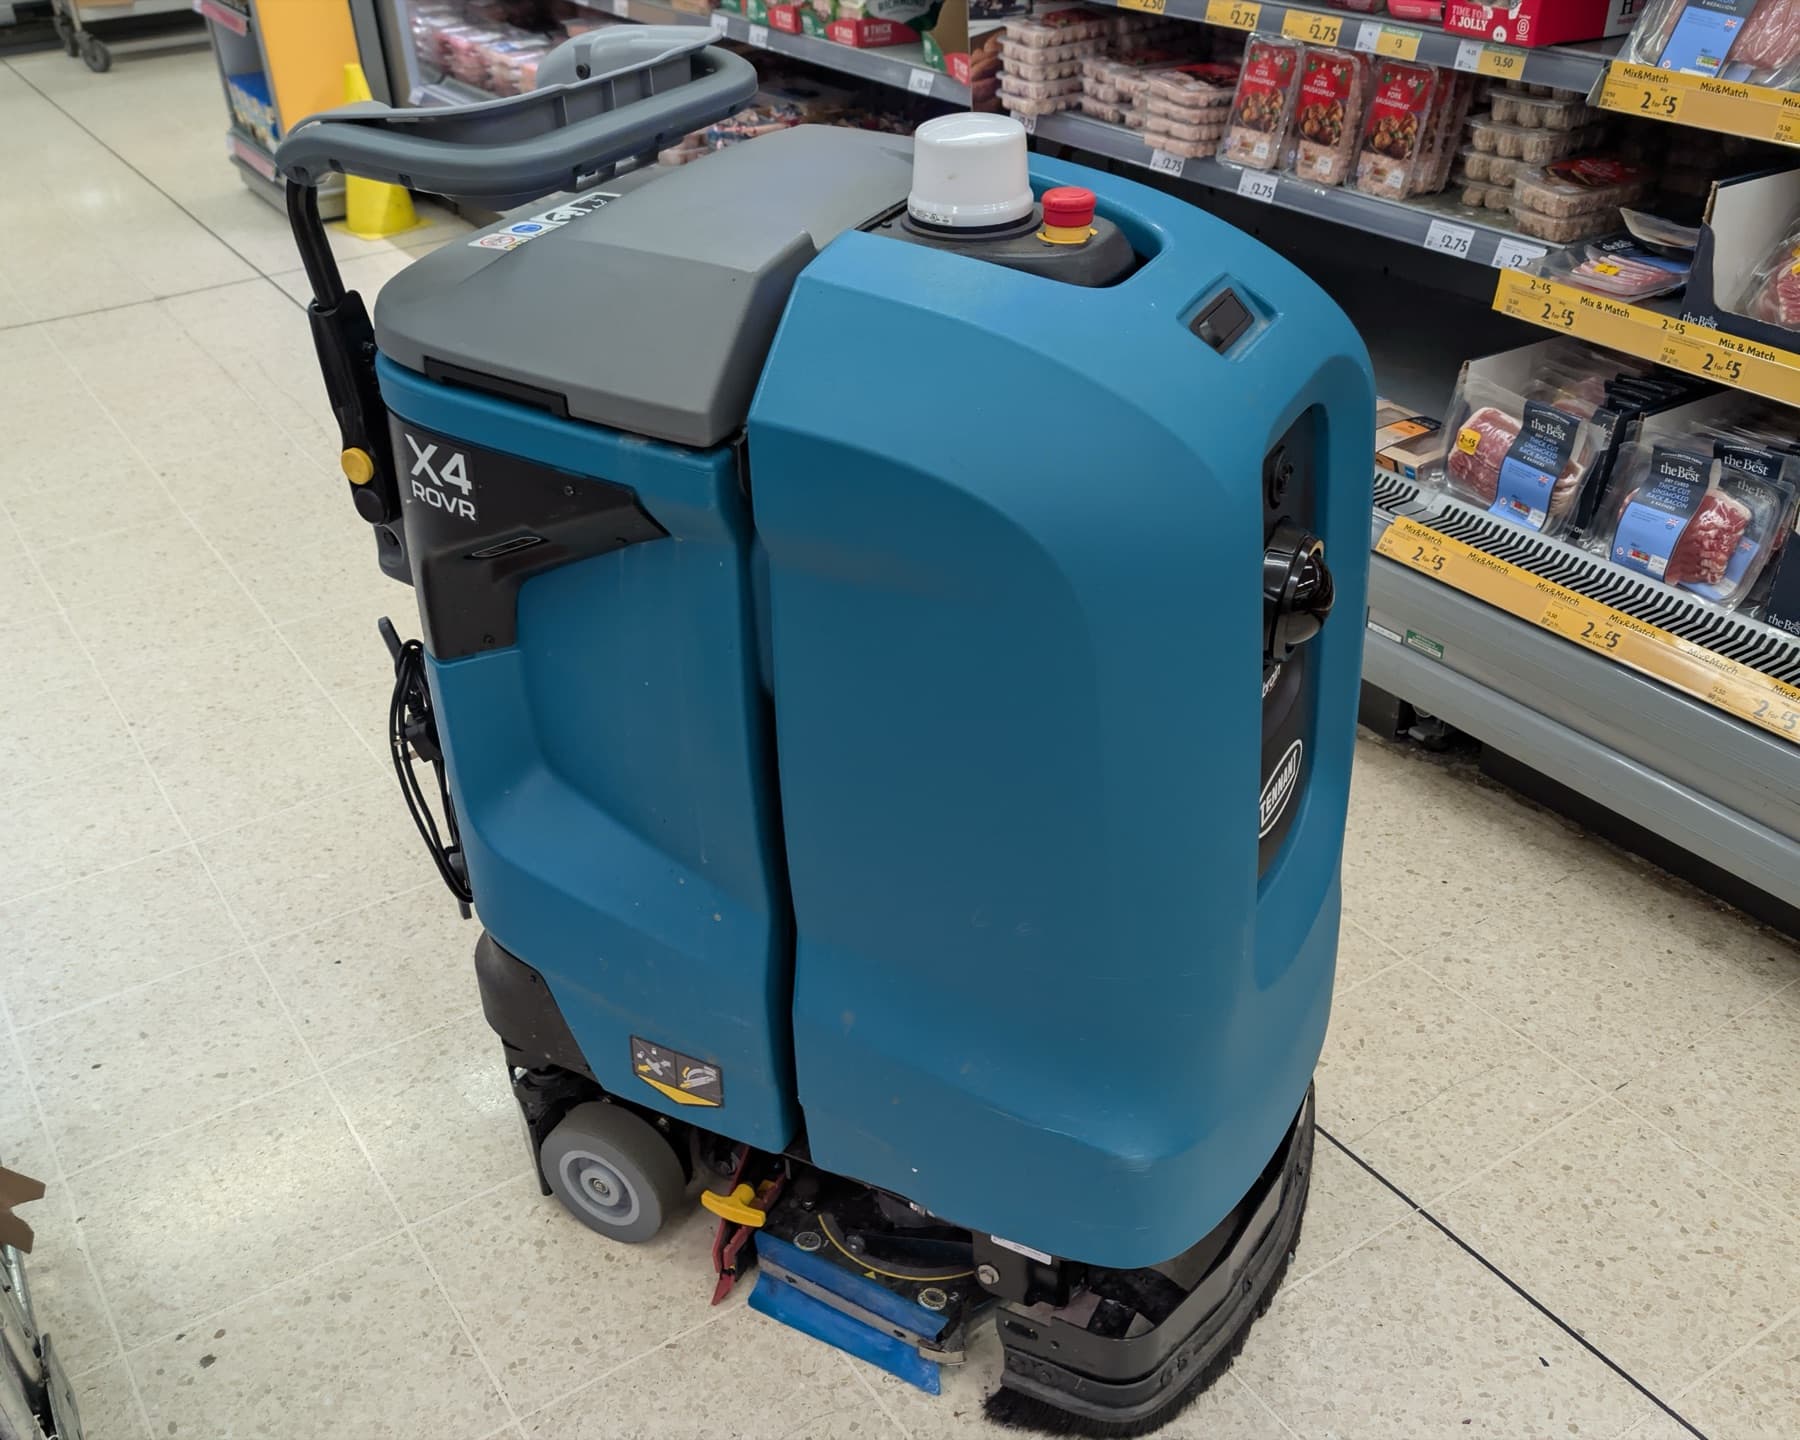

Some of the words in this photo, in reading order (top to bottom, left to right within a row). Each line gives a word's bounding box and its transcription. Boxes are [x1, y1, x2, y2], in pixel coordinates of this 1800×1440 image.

[1230, 11, 1256, 28] £2.75
[1452, 5, 1470, 17] TIME
[1309, 23, 1338, 42] £2.75
[1458, 18, 1489, 32] JOLLY
[1623, 68, 1669, 84] Mix&Match
[1700, 82, 1749, 100] Mix&Match
[1640, 92, 1651, 109] 2
[1662, 95, 1677, 114] £5
[1252, 183, 1273, 199] £2.75
[1441, 235, 1468, 253] £2.75
[1530, 280, 1537, 290] 2
[1541, 303, 1551, 319] 2
[1561, 309, 1575, 326] £5
[1580, 296, 1596, 308] Mix
[1596, 301, 1603, 310] &
[1604, 302, 1630, 318] Match
[1661, 319, 1669, 330] 2
[1675, 323, 1686, 335] £5
[1683, 312, 1698, 325] the
[1697, 315, 1718, 330] Best
[1718, 338, 1736, 351] Mix
[1736, 342, 1745, 353] &
[1746, 345, 1776, 362] Match
[1702, 353, 1714, 370] 2
[1726, 361, 1742, 379] £5
[1459, 434, 1465, 443] 2
[1531, 418, 1546, 432] the
[1546, 423, 1567, 441] Best
[405, 434, 473, 495] X4
[1660, 462, 1678, 476] the
[1677, 467, 1700, 483] Best
[1723, 453, 1742, 469] the
[1742, 459, 1769, 476] Best
[1652, 488, 1689, 502] UNSMOKED
[1658, 482, 1677, 492] THICK
[1677, 487, 1691, 496] CUT
[1737, 479, 1756, 493] the
[411, 480, 477, 521] ROVR
[1664, 497, 1689, 509] BACON
[1403, 523, 1443, 546] Mix&Match
[1411, 546, 1423, 562] 2
[1432, 554, 1446, 570] £5
[1467, 551, 1510, 575] Mix&Match
[1535, 582, 1580, 607] Mix&Match
[1609, 614, 1656, 639] Mix&Match
[1768, 613, 1785, 628] the
[1784, 618, 1800, 635] Bes
[1581, 622, 1594, 638] 2
[1604, 631, 1621, 648] £5
[1753, 700, 1769, 717] 2
[1780, 711, 1800, 730] £5
[1260, 749, 1298, 828] TENNANT
[949, 1292, 959, 1302] 2
